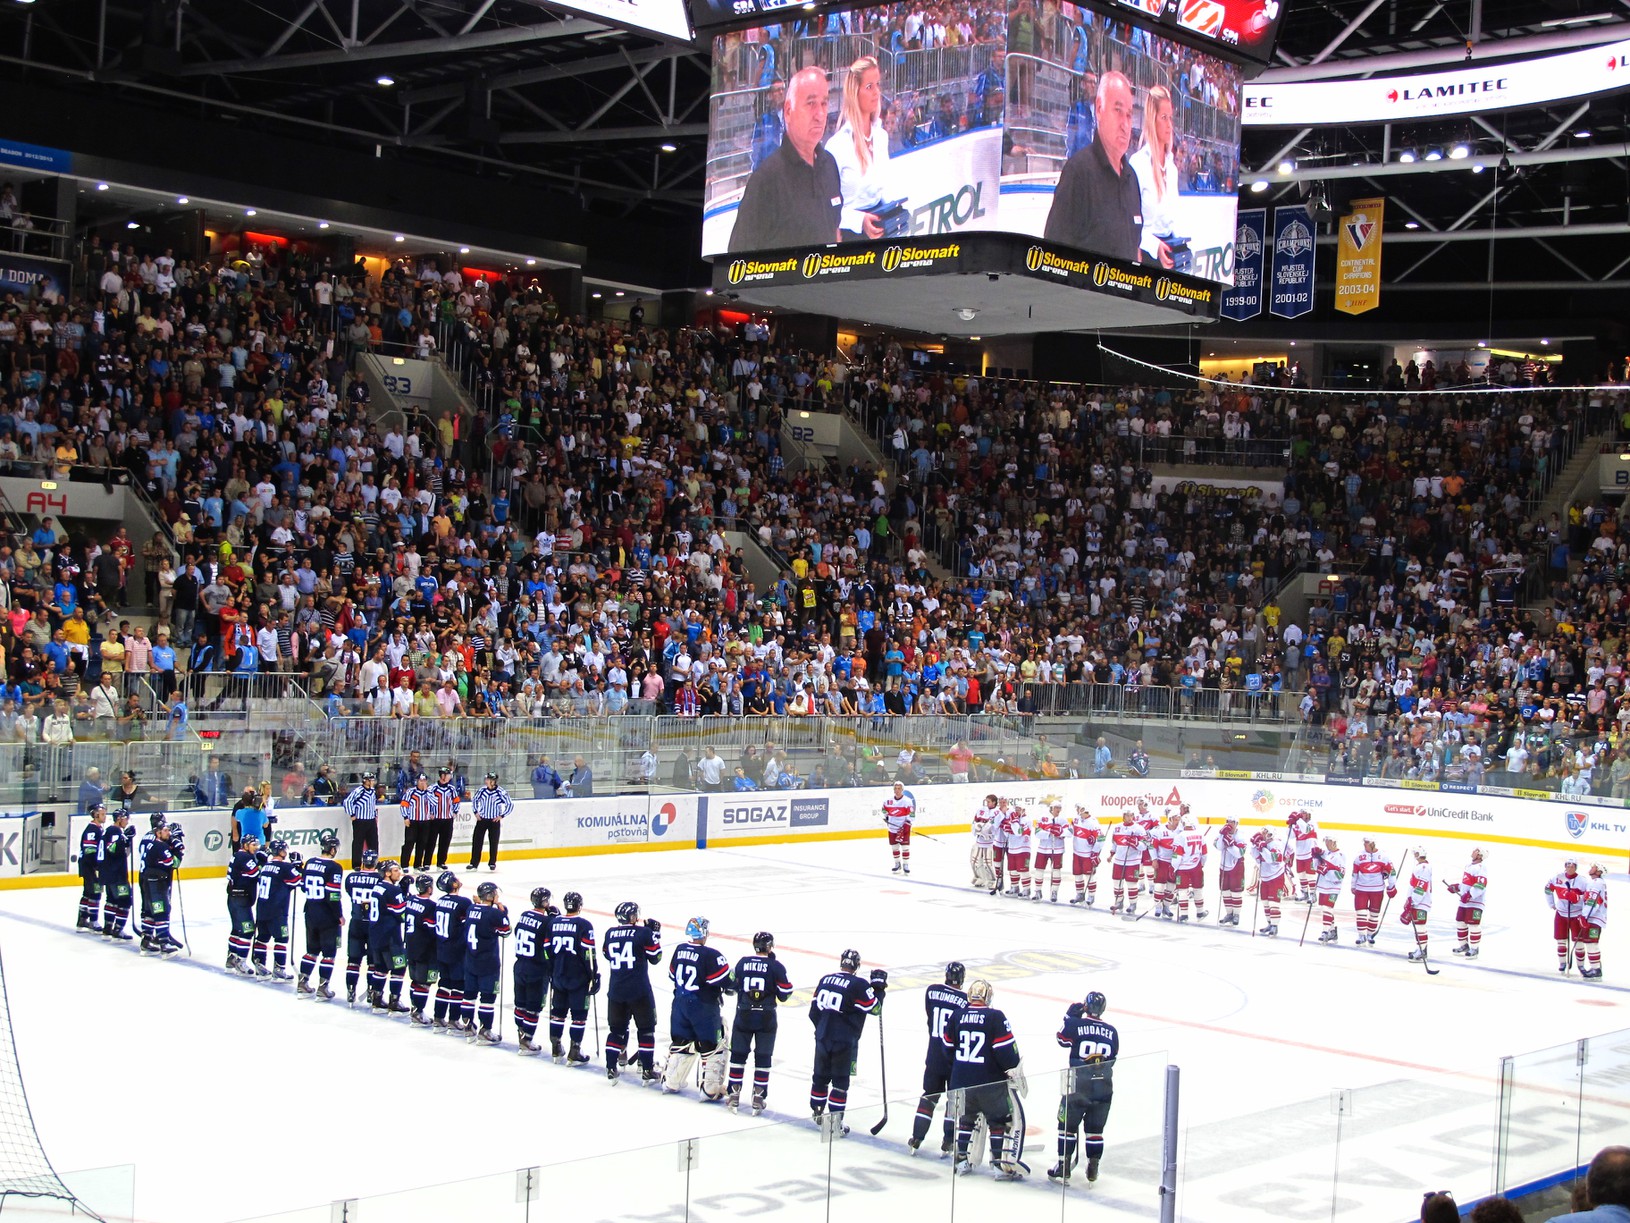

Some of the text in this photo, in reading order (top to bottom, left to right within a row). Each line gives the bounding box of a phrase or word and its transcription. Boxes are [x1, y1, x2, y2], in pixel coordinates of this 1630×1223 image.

[1404, 78, 1507, 100] LAMITEC
[909, 182, 985, 236] ETROL
[821, 252, 876, 268] Slovnaft
[902, 245, 960, 261] Slovnaft
[745, 259, 798, 274] Slovnaft
[900, 259, 934, 268] arena
[1043, 252, 1089, 275] Slovnaft
[745, 273, 773, 281] arena
[820, 266, 850, 276] arena
[1041, 265, 1068, 277] arena
[1276, 271, 1308, 280] SLOVENSKEJ
[1107, 280, 1132, 291] arena
[1108, 268, 1151, 289] Slovnaft
[1279, 278, 1306, 287] REPUBLIKY
[1170, 283, 1210, 302] Slovnaft
[1168, 295, 1192, 305] arena
[792, 426, 814, 442] B2
[27, 492, 66, 515] A4
[1250, 677, 1260, 687] 23
[1256, 772, 1283, 781] KHL.RU
[1411, 782, 1436, 790] Slovnaft
[1523, 791, 1547, 799] Slovnaft
[1555, 793, 1582, 803] KHL.RU
[1279, 798, 1323, 807] OSTCHEM
[723, 806, 787, 824] SOGAZ
[800, 812, 819, 820] GROUP
[1427, 807, 1494, 821] UniCredit Bank
[1591, 822, 1626, 832] KHL TV
[1187, 841, 1202, 856] 77
[305, 876, 325, 899] 56
[350, 876, 379, 885] STASTNY
[436, 911, 450, 938] 91
[468, 924, 478, 950] 4
[610, 929, 636, 938] PRINTZ
[516, 927, 536, 957] 85
[608, 941, 636, 970] 54
[743, 962, 768, 972] MIKUS
[675, 963, 699, 991] 42
[928, 990, 968, 1009] KUKUMBERG
[959, 1014, 985, 1025] JANUS
[1077, 1026, 1114, 1041] HUDACEK
[955, 1030, 986, 1064] 32
